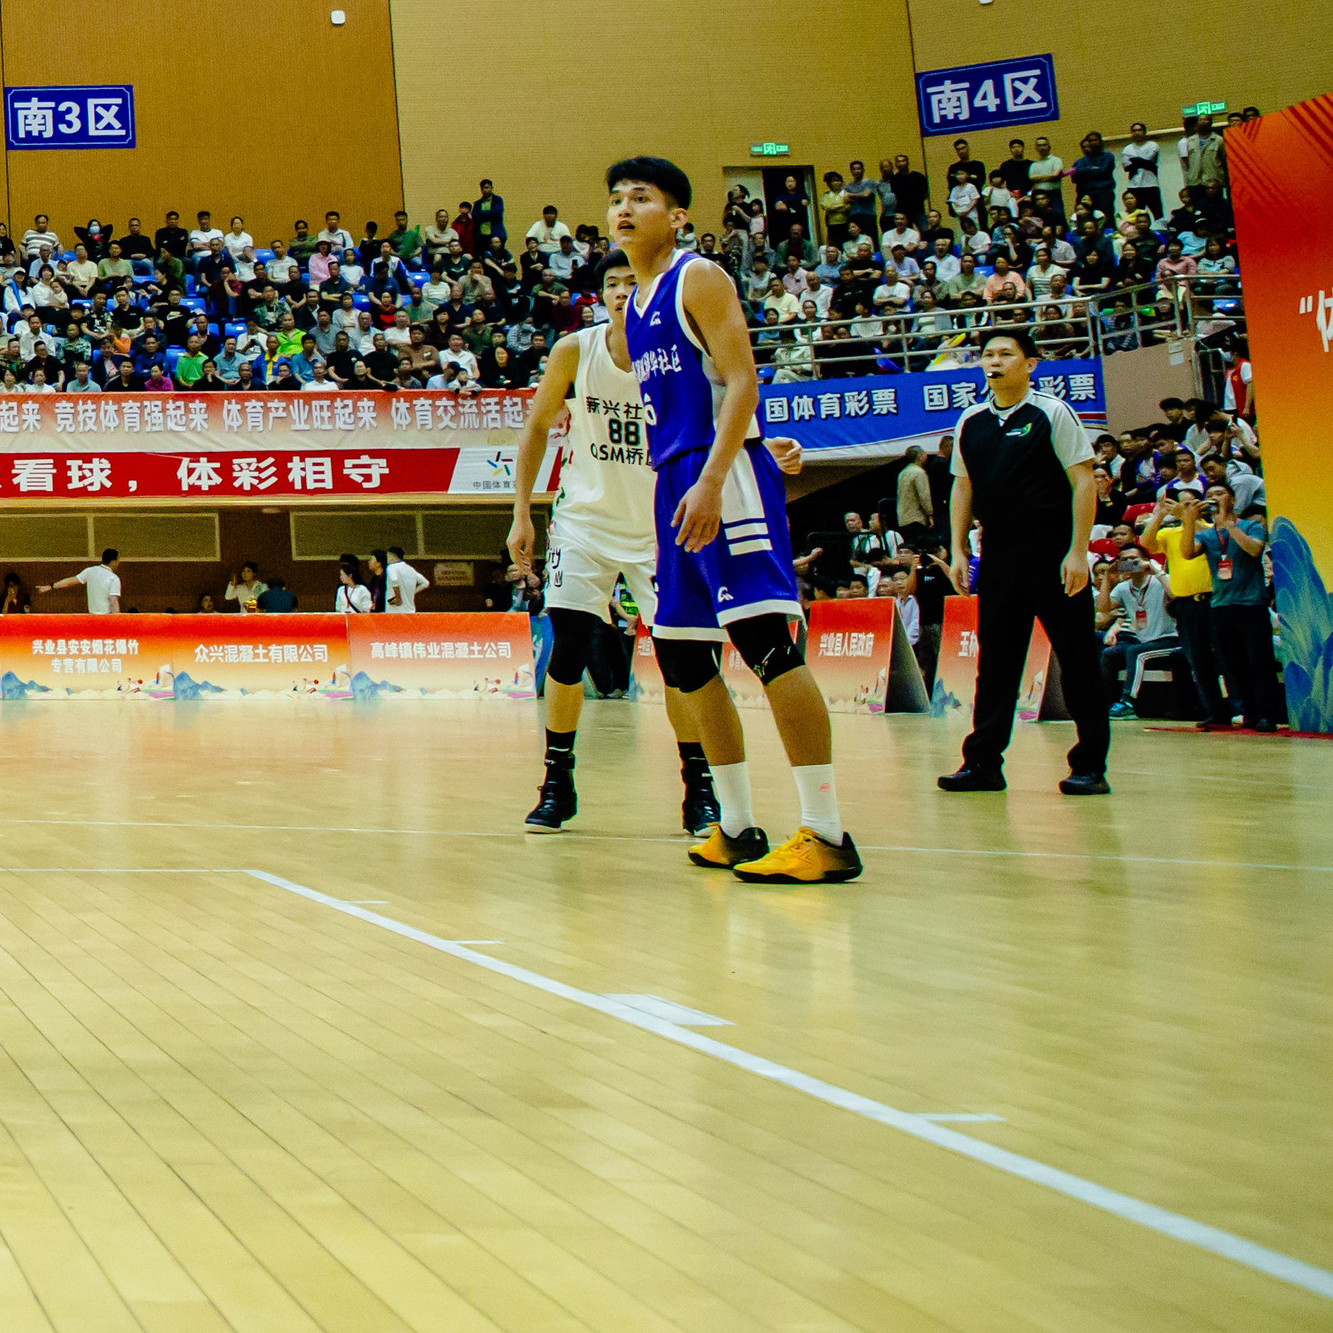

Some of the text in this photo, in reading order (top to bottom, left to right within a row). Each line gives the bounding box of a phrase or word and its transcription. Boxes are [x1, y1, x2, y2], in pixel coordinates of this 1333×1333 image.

[927, 69, 1047, 123] 南4区
[14, 97, 126, 138] 南3区
[55, 398, 208, 433] 竞技体育强起来
[223, 398, 377, 432] 体育产业旺起来
[765, 389, 897, 424] 国体育彩票
[608, 419, 641, 445] 88
[194, 643, 328, 663] 众兴混凝土有限公司
[370, 642, 512, 659] 高峰镇伟业混凝土公司
[818, 632, 875, 657] 兴业县人民政府
[51, 658, 122, 674] 专营有限公司
